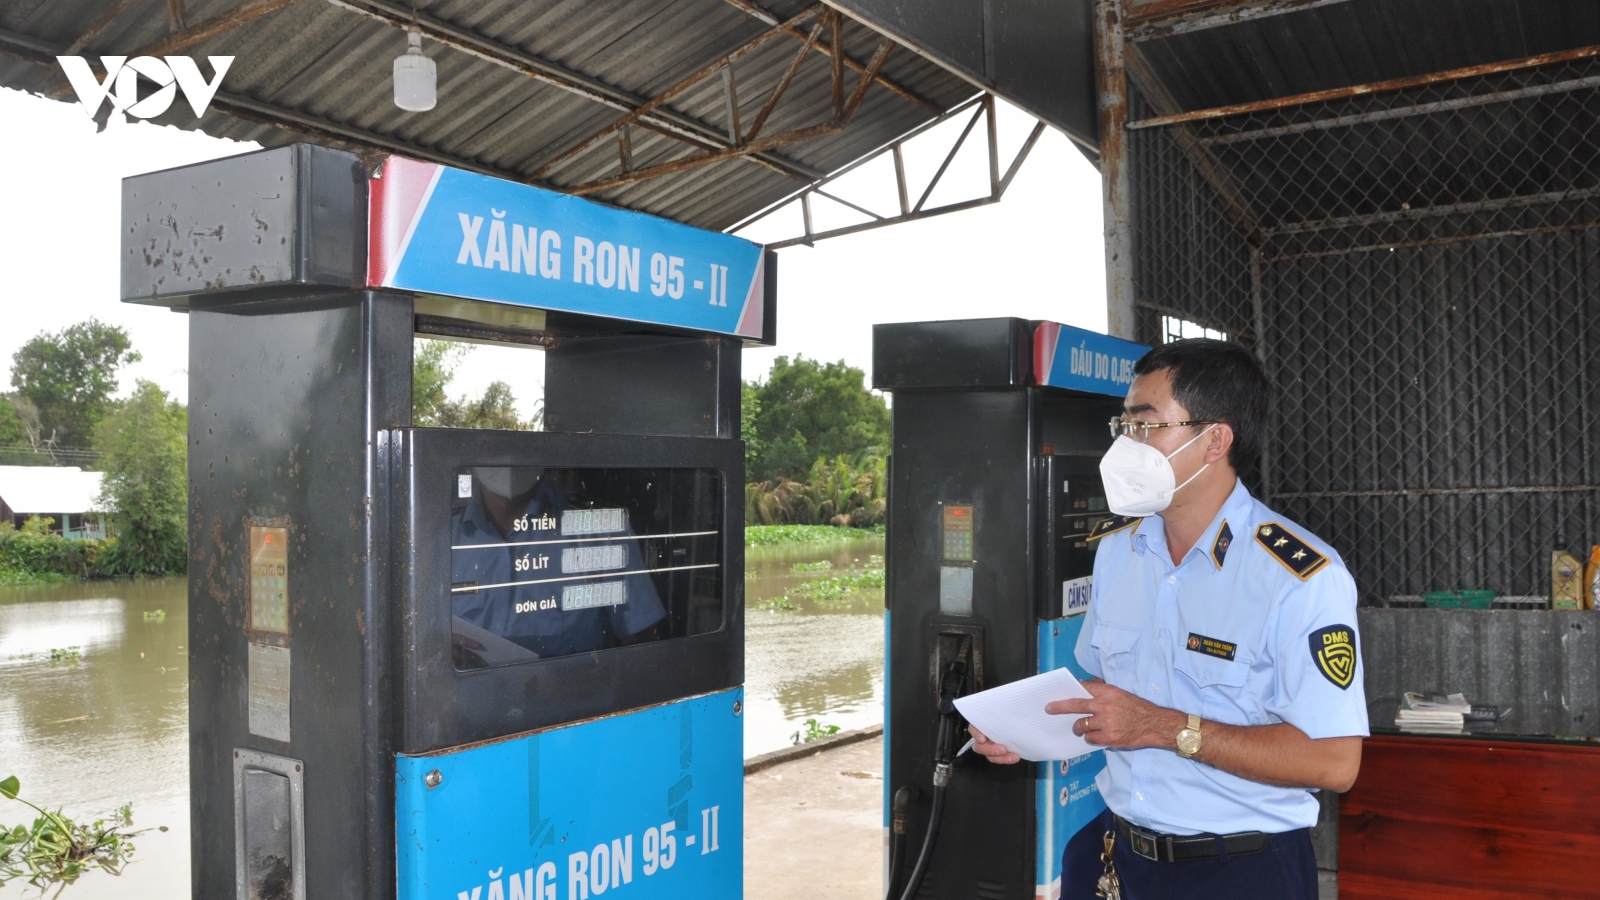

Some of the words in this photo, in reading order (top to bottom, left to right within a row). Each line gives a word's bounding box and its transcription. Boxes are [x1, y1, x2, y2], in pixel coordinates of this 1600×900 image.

[456, 208, 561, 280] XĂNG
[573, 236, 640, 292] RON
[650, 253, 684, 299] 95
[694, 280, 703, 290] -
[709, 263, 728, 307] II
[1095, 352, 1109, 380] DO
[513, 513, 529, 532] SỐ
[531, 513, 556, 531] TIỀN
[515, 553, 530, 571] SỐ
[532, 553, 549, 570] LÍT
[515, 600, 537, 614] ĐƠN
[539, 596, 557, 610] GIÁ
[1322, 631, 1349, 645] DMS
[568, 834, 633, 900] RON
[642, 820, 676, 876] 95
[685, 834, 696, 846] -
[701, 805, 720, 855] II
